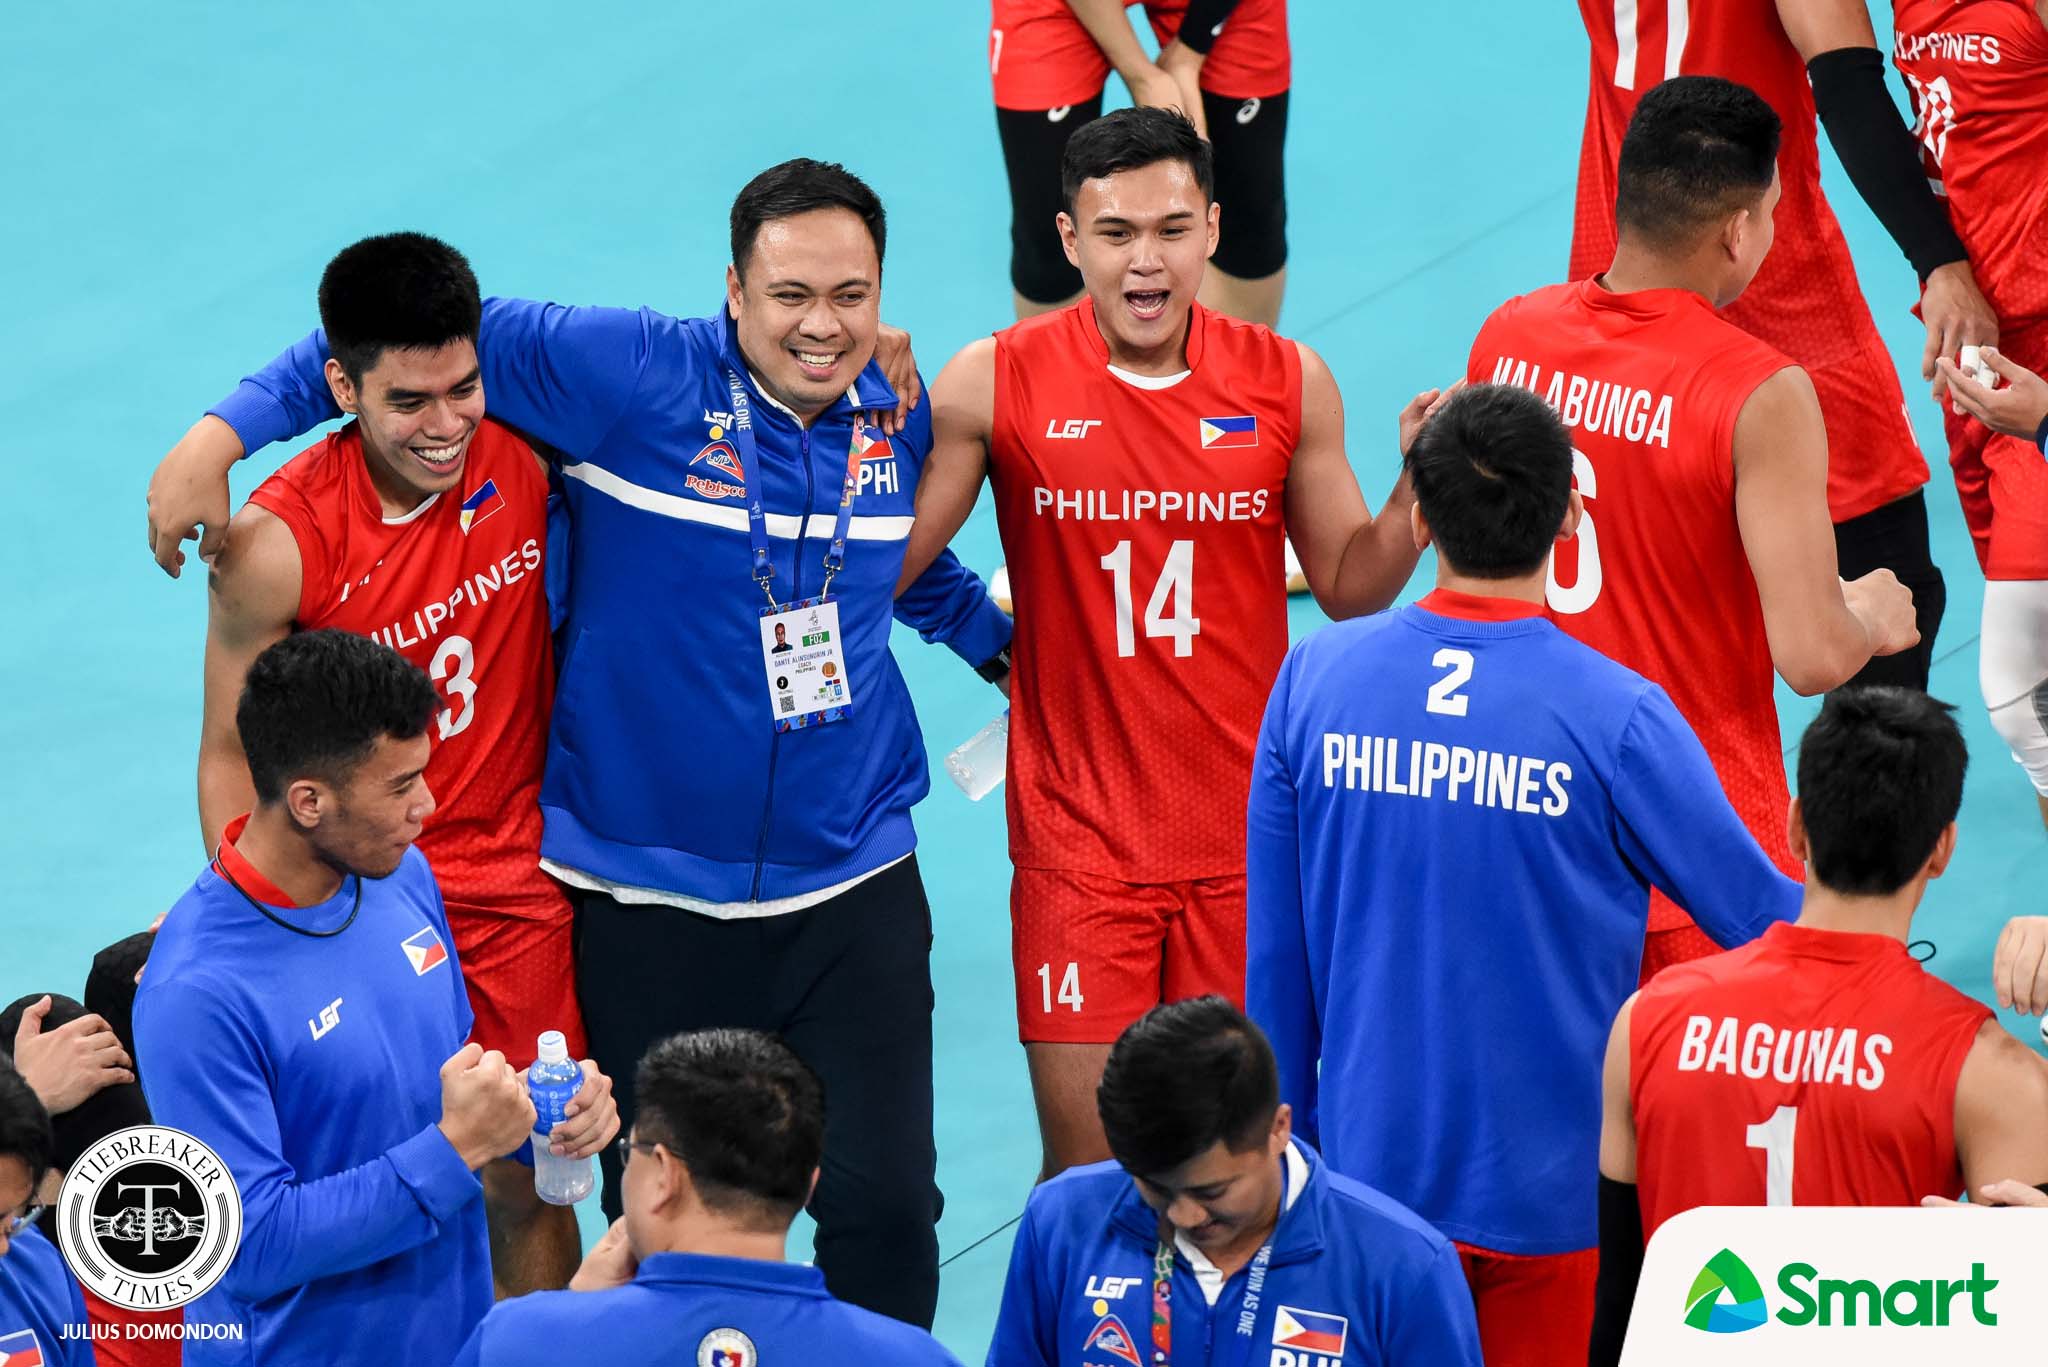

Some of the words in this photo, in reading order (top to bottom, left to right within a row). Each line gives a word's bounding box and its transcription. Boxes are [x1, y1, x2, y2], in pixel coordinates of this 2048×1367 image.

[1894, 30, 2001, 65] ILIPPINES
[731, 392, 748, 408] AS
[735, 408, 752, 432] ONE
[685, 474, 747, 499] Rebisco
[855, 461, 899, 496] PHI
[1034, 486, 1269, 522] PHILIPPINES
[371, 538, 541, 650] ILIPPINES
[1101, 540, 1201, 658] 14
[429, 635, 478, 741] 3
[1426, 648, 1475, 717] 2
[1323, 733, 1573, 817] PHILIPPINES
[1037, 962, 1084, 1013] 14
[1678, 1015, 1893, 1091] BAGUNAS
[1745, 1105, 1798, 1207] 1
[1246, 1265, 1267, 1293] WIN
[1242, 1291, 1261, 1311] AS
[1236, 1310, 1257, 1337] ONE
